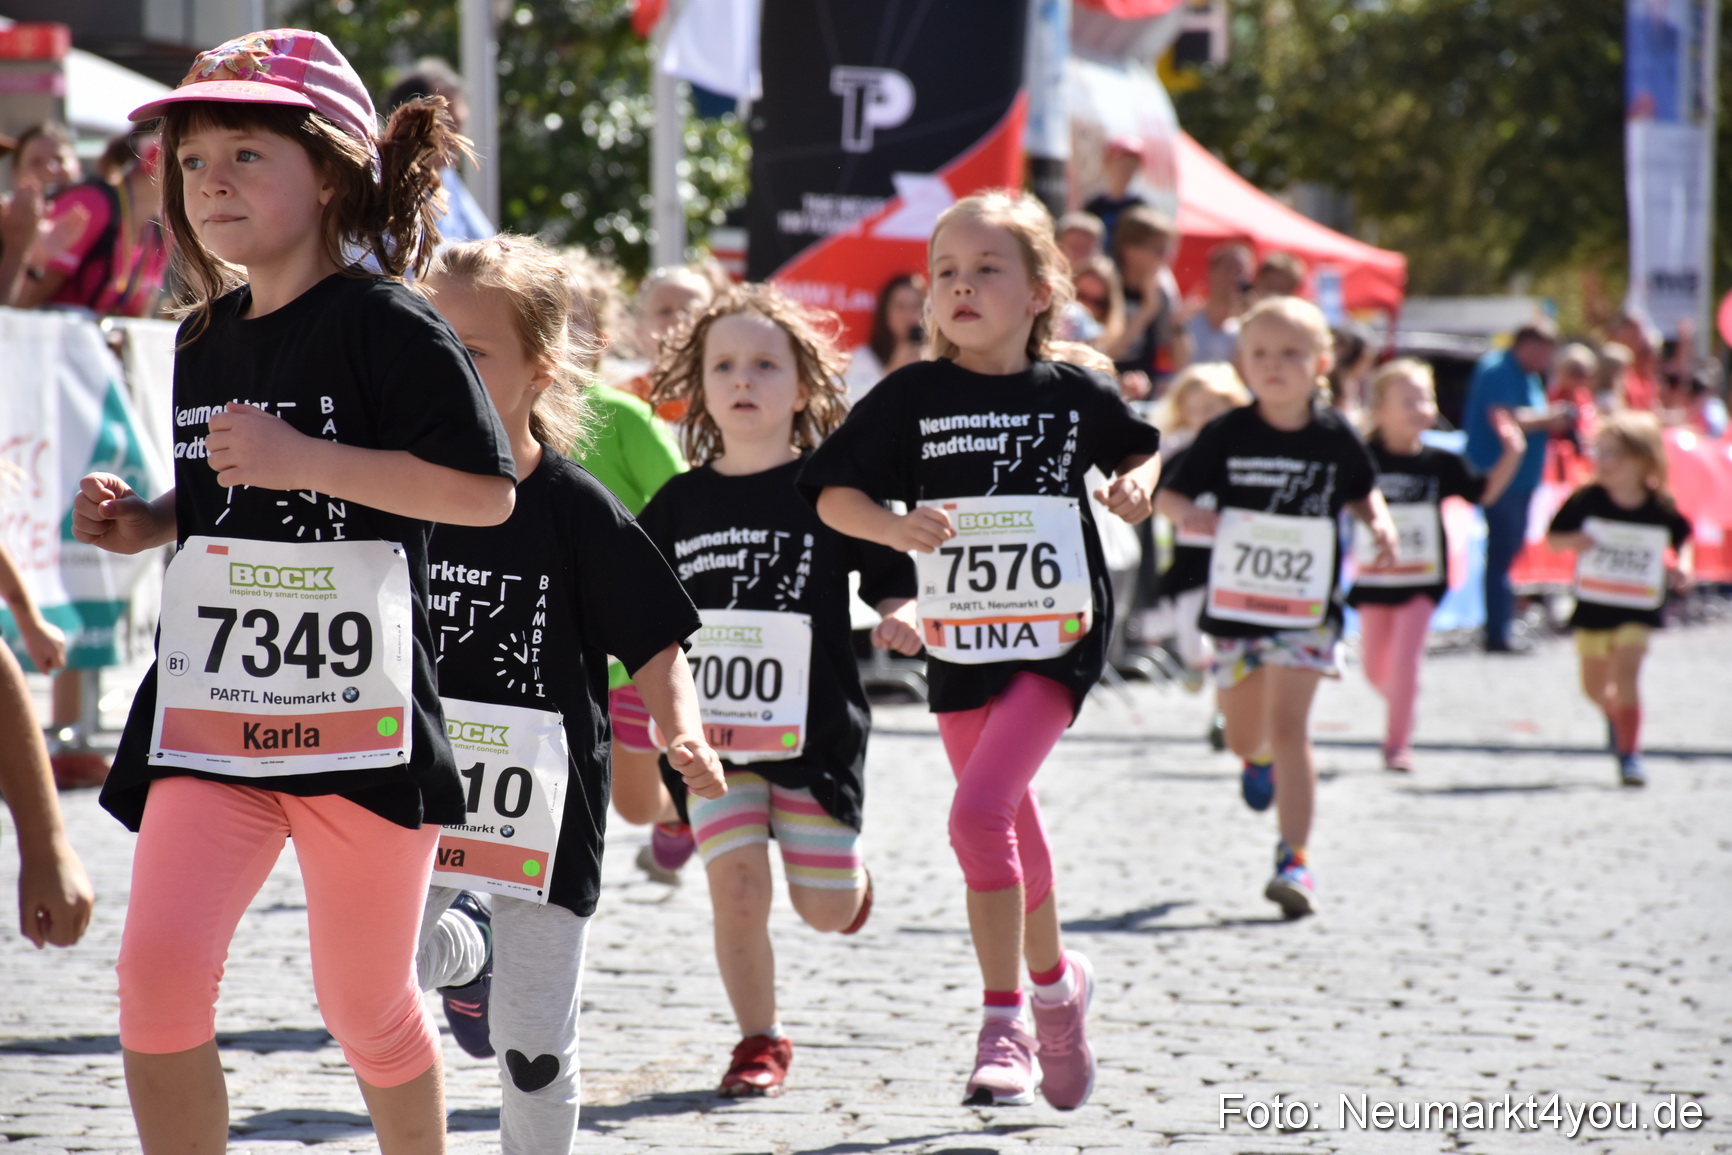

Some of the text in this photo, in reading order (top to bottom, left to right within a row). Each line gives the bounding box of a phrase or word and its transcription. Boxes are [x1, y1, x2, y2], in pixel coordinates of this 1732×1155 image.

[919, 411, 1031, 436] Neumarkter
[921, 432, 1009, 460] Stadtlauf
[958, 511, 1034, 530] BOCK
[939, 542, 1062, 594] 7576
[1234, 542, 1314, 582] 7032
[229, 562, 337, 591] BOCK
[229, 588, 338, 601] inspired by smart concepts
[950, 600, 1039, 611] PARTL Neumarkt
[197, 605, 374, 680] 7349
[697, 625, 763, 643] BOCK
[955, 621, 1039, 650] LINA
[169, 657, 184, 671] B1
[689, 655, 783, 703] 7000
[210, 687, 337, 705] PARTL Neumarkt
[243, 721, 320, 750] Karla
[446, 719, 510, 747] OCK
[454, 742, 475, 751] smart
[476, 745, 509, 755] concepts
[461, 762, 533, 818] 10
[440, 823, 495, 834] eumarkt
[437, 847, 466, 868] va
